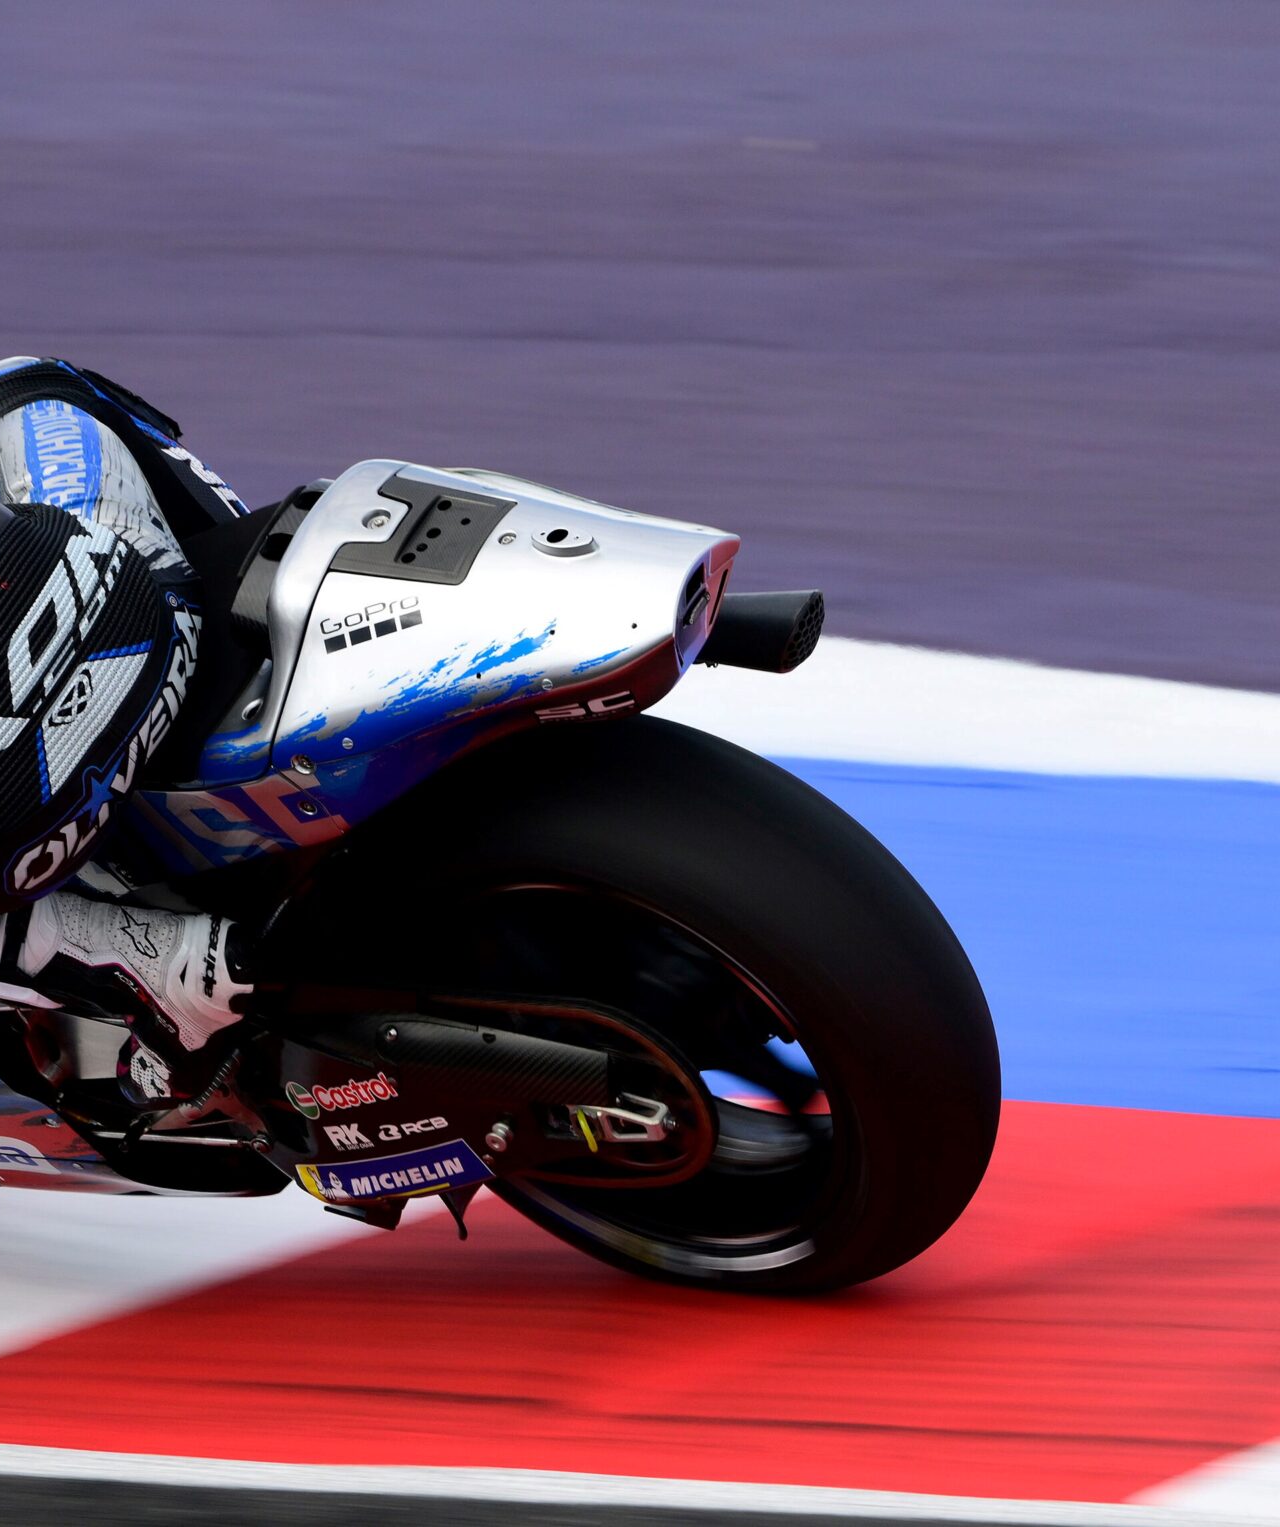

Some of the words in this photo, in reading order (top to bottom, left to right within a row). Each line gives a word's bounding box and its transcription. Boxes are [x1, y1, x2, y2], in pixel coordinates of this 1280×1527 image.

[319, 596, 420, 635] GoPro
[312, 1071, 399, 1111] Castrol
[323, 1122, 373, 1147] RK
[400, 1116, 449, 1136] RCB
[351, 1157, 465, 1197] MICHELIN
